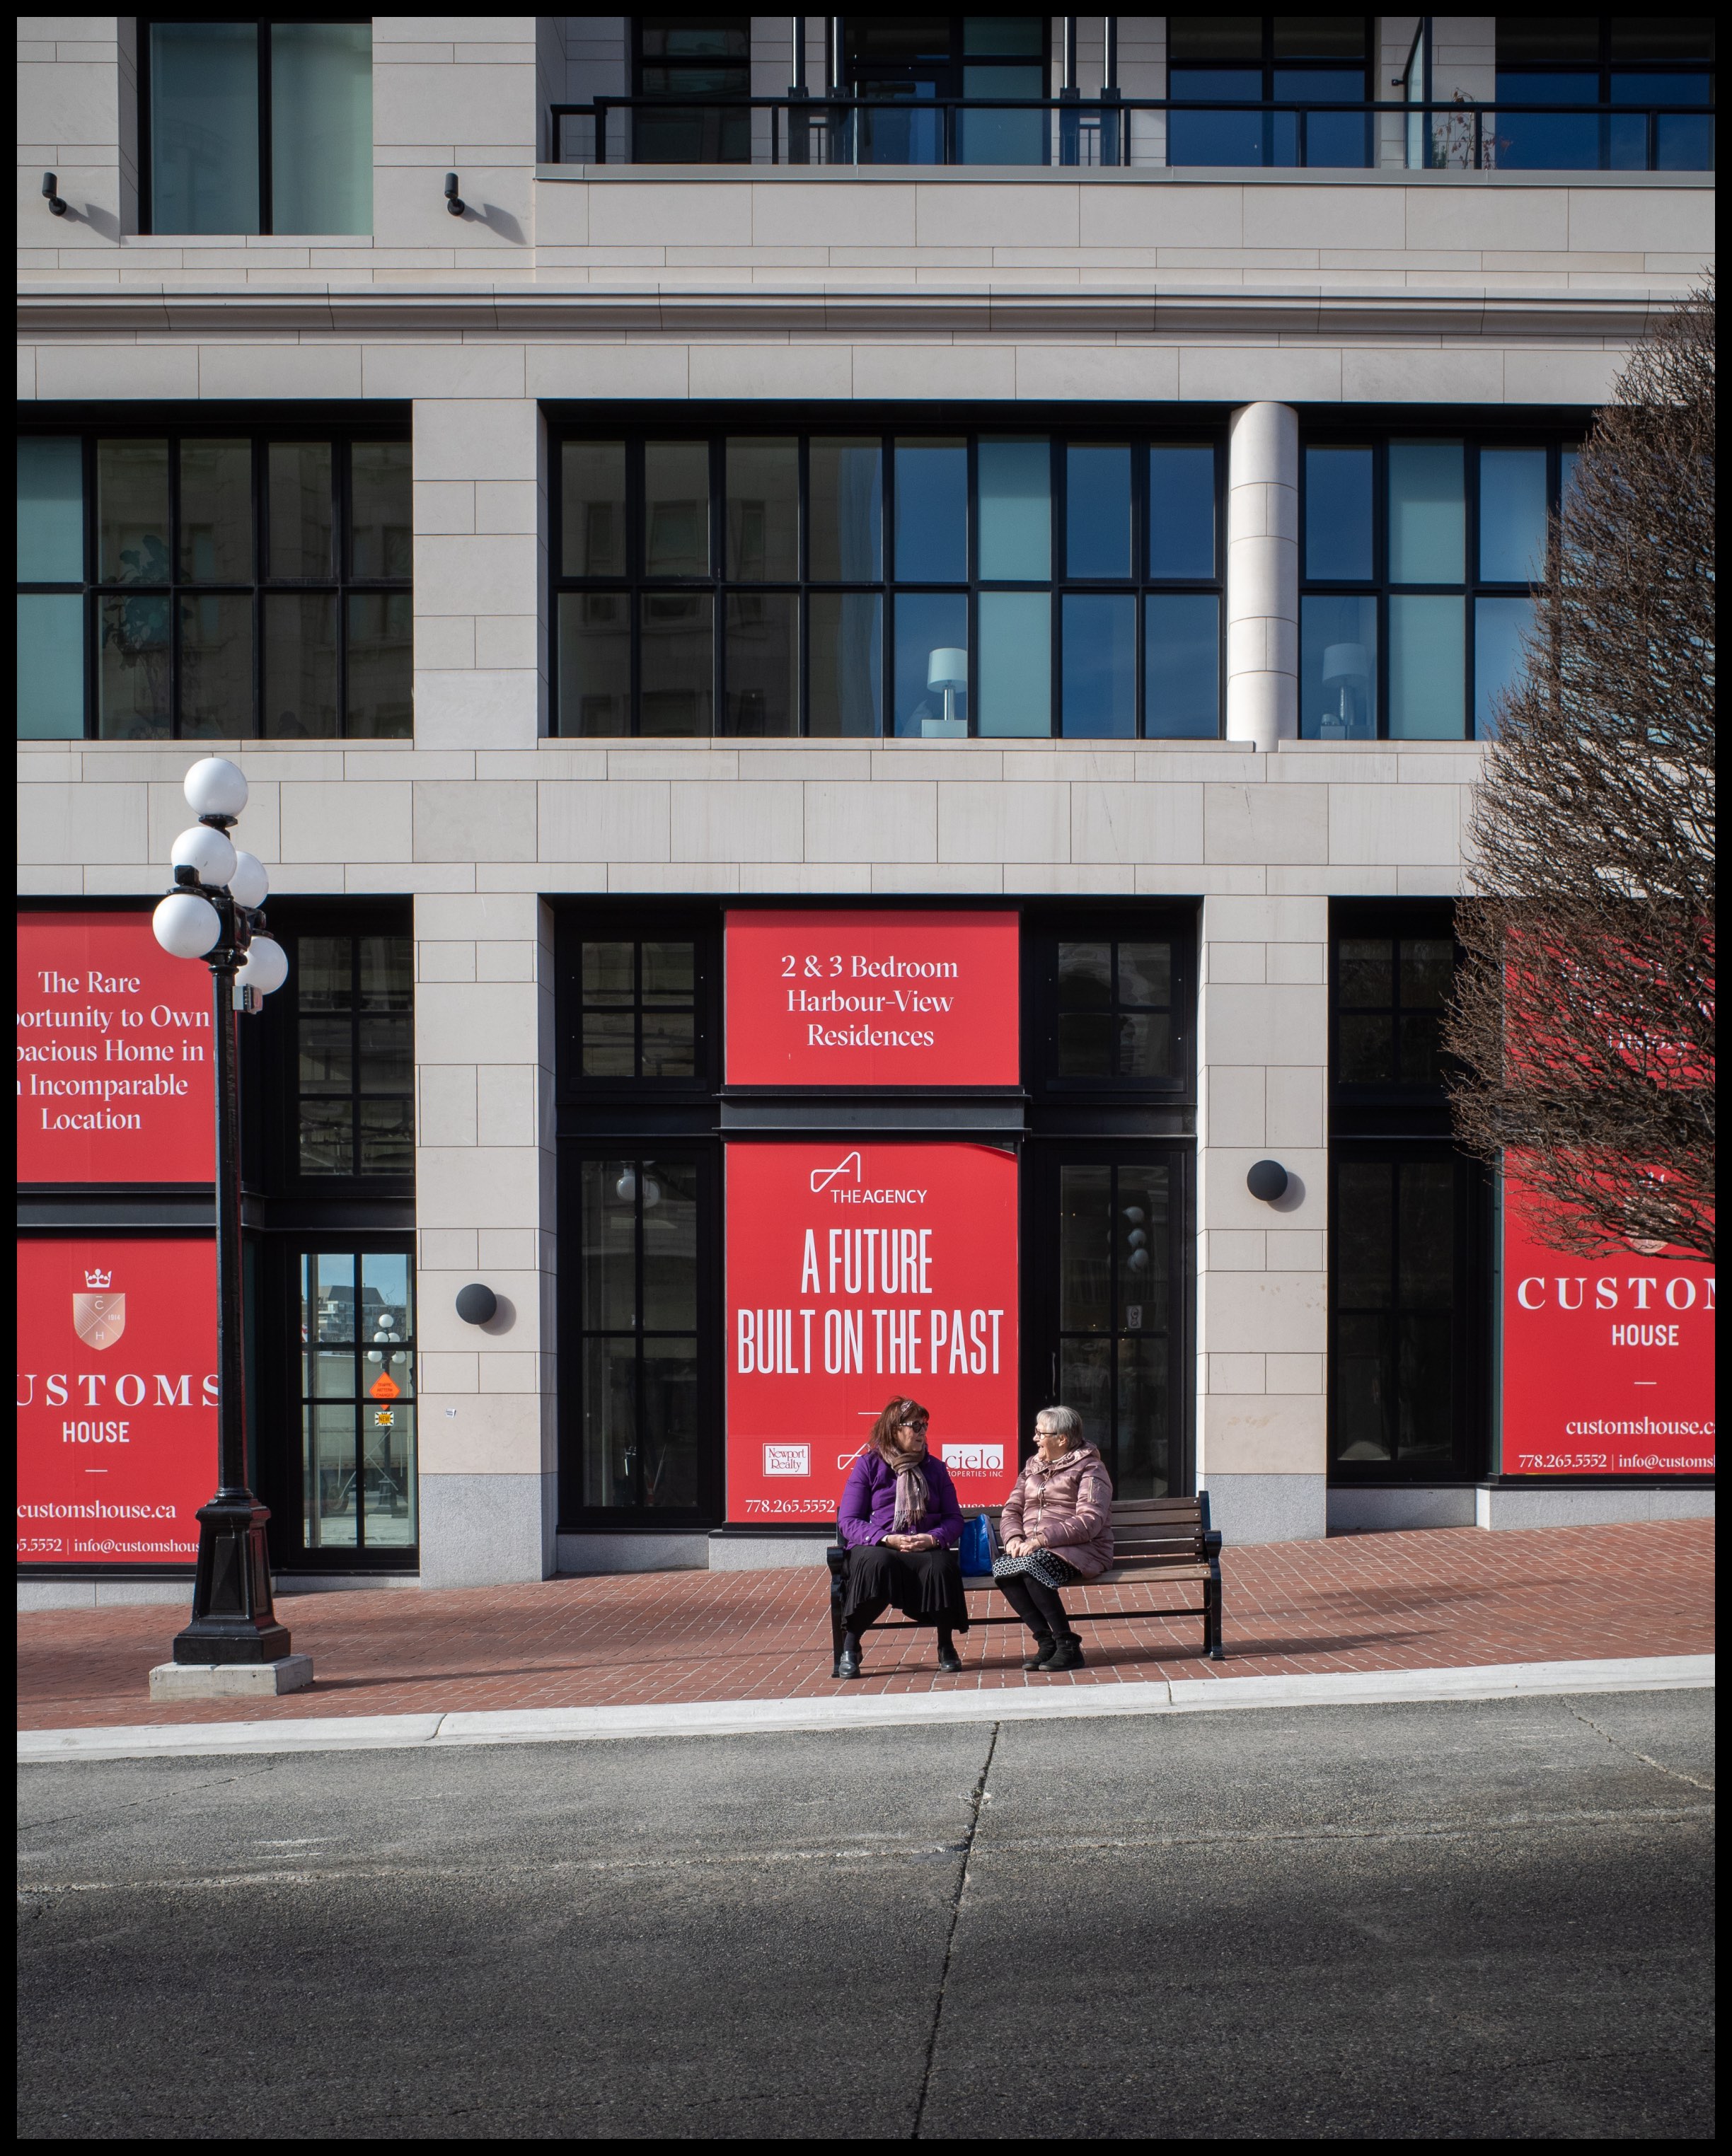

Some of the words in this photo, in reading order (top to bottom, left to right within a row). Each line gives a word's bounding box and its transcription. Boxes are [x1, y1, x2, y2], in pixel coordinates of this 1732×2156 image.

[781, 955, 796, 977] 2
[804, 955, 823, 978] &
[829, 955, 843, 977] 3
[851, 955, 959, 978] Bedroom
[37, 971, 79, 993] The
[87, 971, 141, 993] Rare
[787, 990, 954, 1012] Harbour-View
[17, 1005, 112, 1033] ortunity
[121, 1009, 144, 1027] to
[150, 1004, 209, 1027] Own
[807, 1024, 934, 1046] Residences
[105, 1039, 174, 1061] Home
[182, 1039, 204, 1061] in
[30, 1073, 188, 1101] Incomparable
[40, 1108, 142, 1130] Location
[801, 1229, 821, 1294] A
[829, 1229, 933, 1294] FUTURE
[96, 1331, 104, 1340] H
[737, 1309, 816, 1374] BUILT
[824, 1309, 863, 1374] ON
[872, 1309, 922, 1374] THE
[930, 1309, 1004, 1374] PAST
[1612, 1324, 1679, 1346] HOUSE
[62, 1421, 129, 1443] HOUSE
[1566, 1416, 1715, 1435] customshouse.c
[768, 1447, 807, 1461] Newport
[945, 1449, 1000, 1469] cielo
[1518, 1454, 1607, 1468] 778.265.5552
[1619, 1454, 1715, 1469] info@customs
[770, 1458, 802, 1473] Realty
[17, 1500, 176, 1519] customshouse.ca
[745, 1499, 836, 1513] 778.265.5552
[17, 1538, 62, 1551] 5.5552
